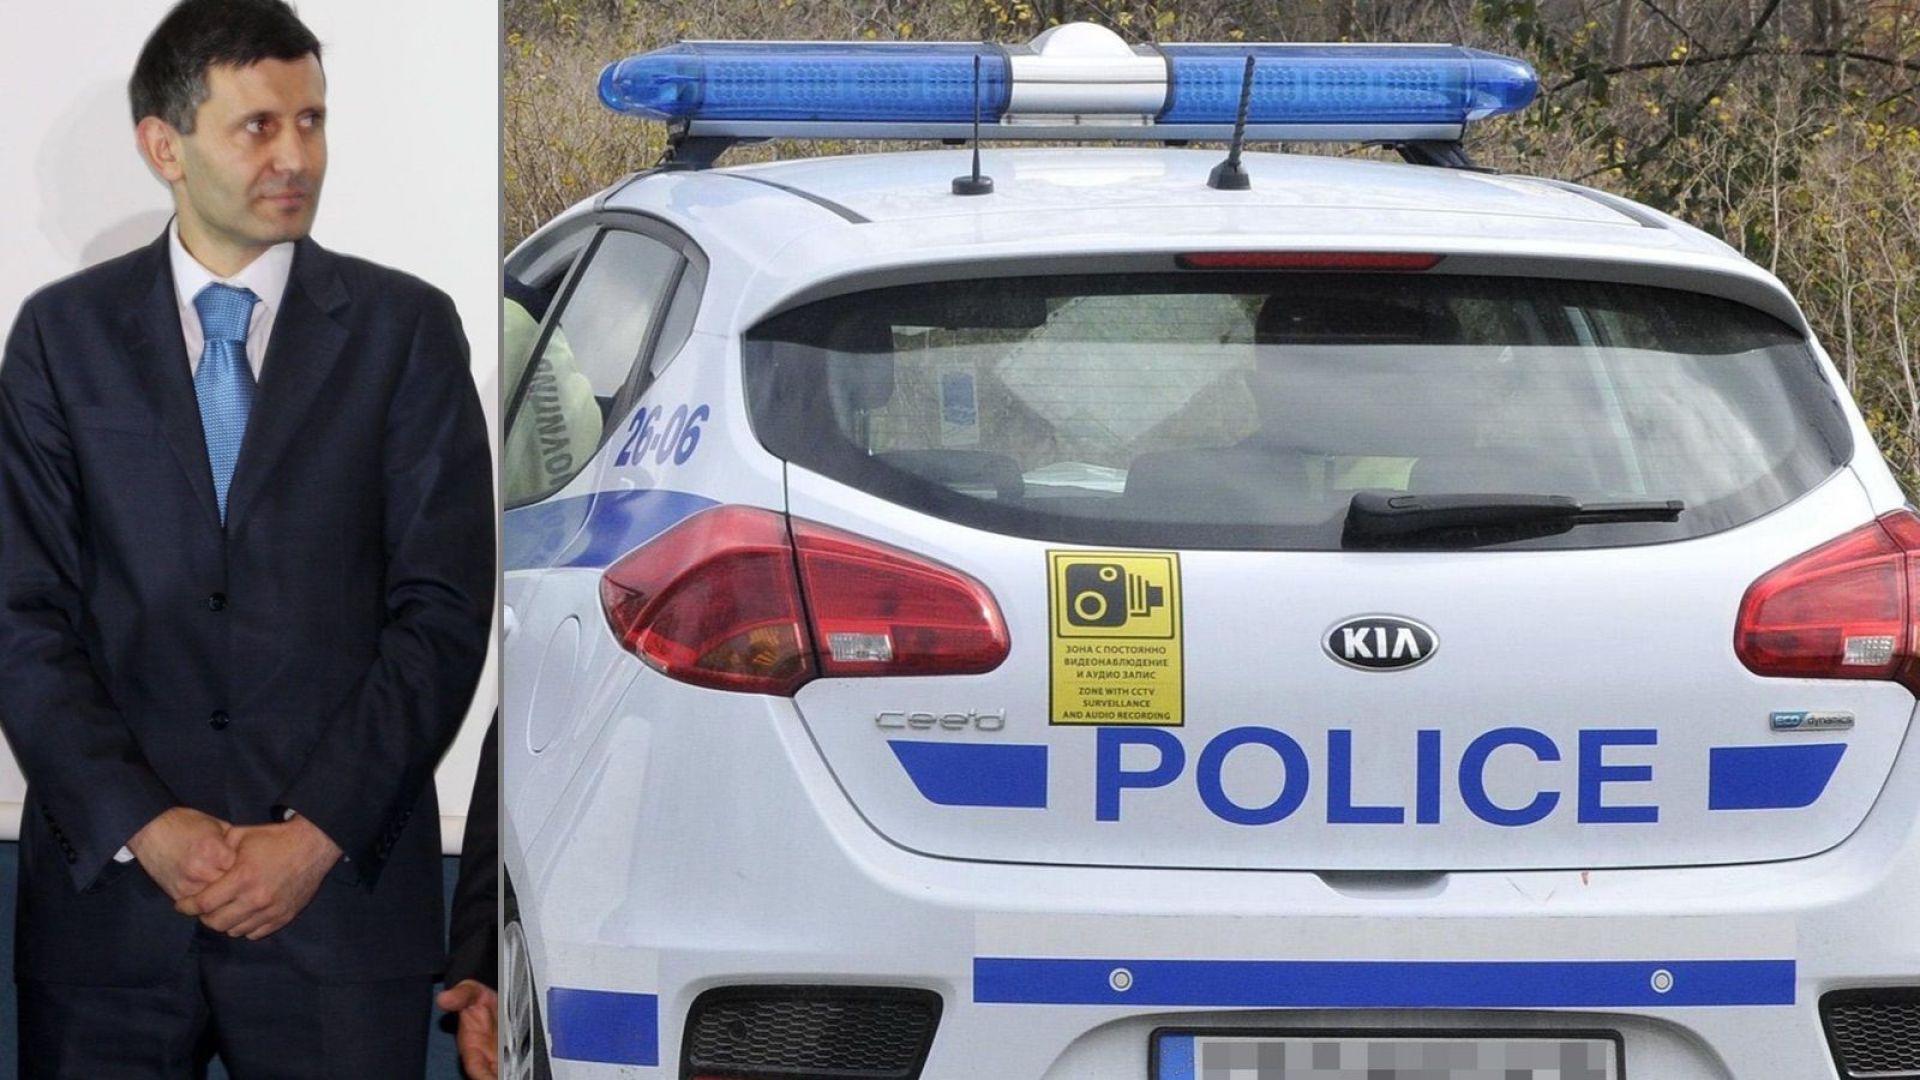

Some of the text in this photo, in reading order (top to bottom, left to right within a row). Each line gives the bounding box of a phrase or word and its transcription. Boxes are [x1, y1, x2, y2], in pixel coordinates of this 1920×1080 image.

[613, 403, 710, 467] 26-06
[1104, 646, 1166, 654] ПОСТОЯННО
[1342, 626, 1421, 659] KIA
[1064, 658, 1168, 667] ВИДЕОНАБЛЮДЕНИЕ
[1086, 671, 1120, 679] АУДИО
[1122, 671, 1156, 679] ЗАПИС
[875, 708, 1006, 731] cee'd
[1117, 712, 1170, 720] RECORDING
[1095, 726, 1658, 826] POLICE
